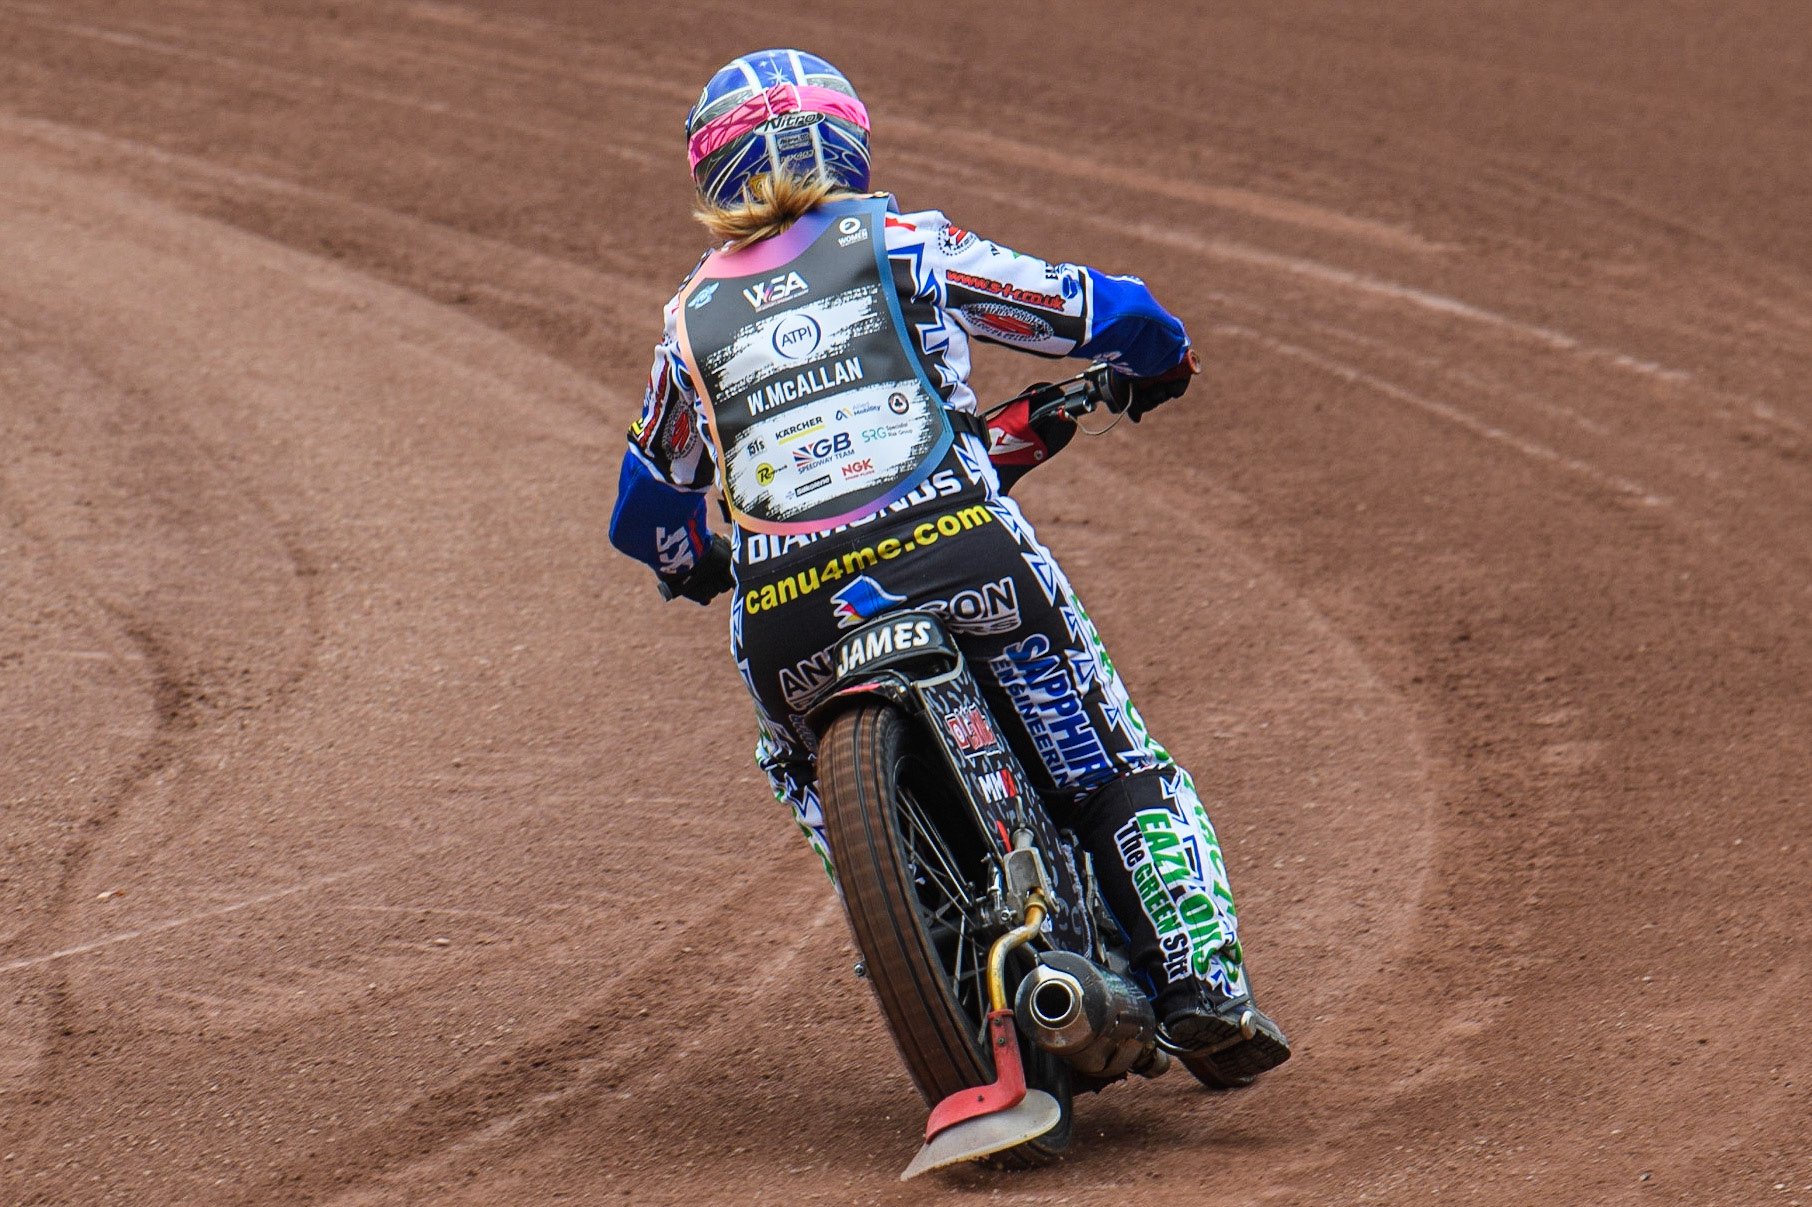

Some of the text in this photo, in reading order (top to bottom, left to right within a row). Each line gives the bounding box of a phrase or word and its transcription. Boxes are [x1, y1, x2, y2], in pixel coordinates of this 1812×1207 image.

[763, 113, 816, 132] Nitro
[781, 326, 812, 347] ATPI
[853, 404, 882, 416] Mobility
[812, 432, 851, 459] GB
[861, 427, 888, 443] SRG
[798, 455, 833, 475] SPEEDWAY
[834, 449, 856, 461] TEAM
[841, 458, 873, 476] NGK
[745, 504, 994, 615] canu4me.com
[836, 621, 931, 678] JAMES
[1117, 818, 1146, 868] The
[1133, 860, 1182, 937] GREEN
